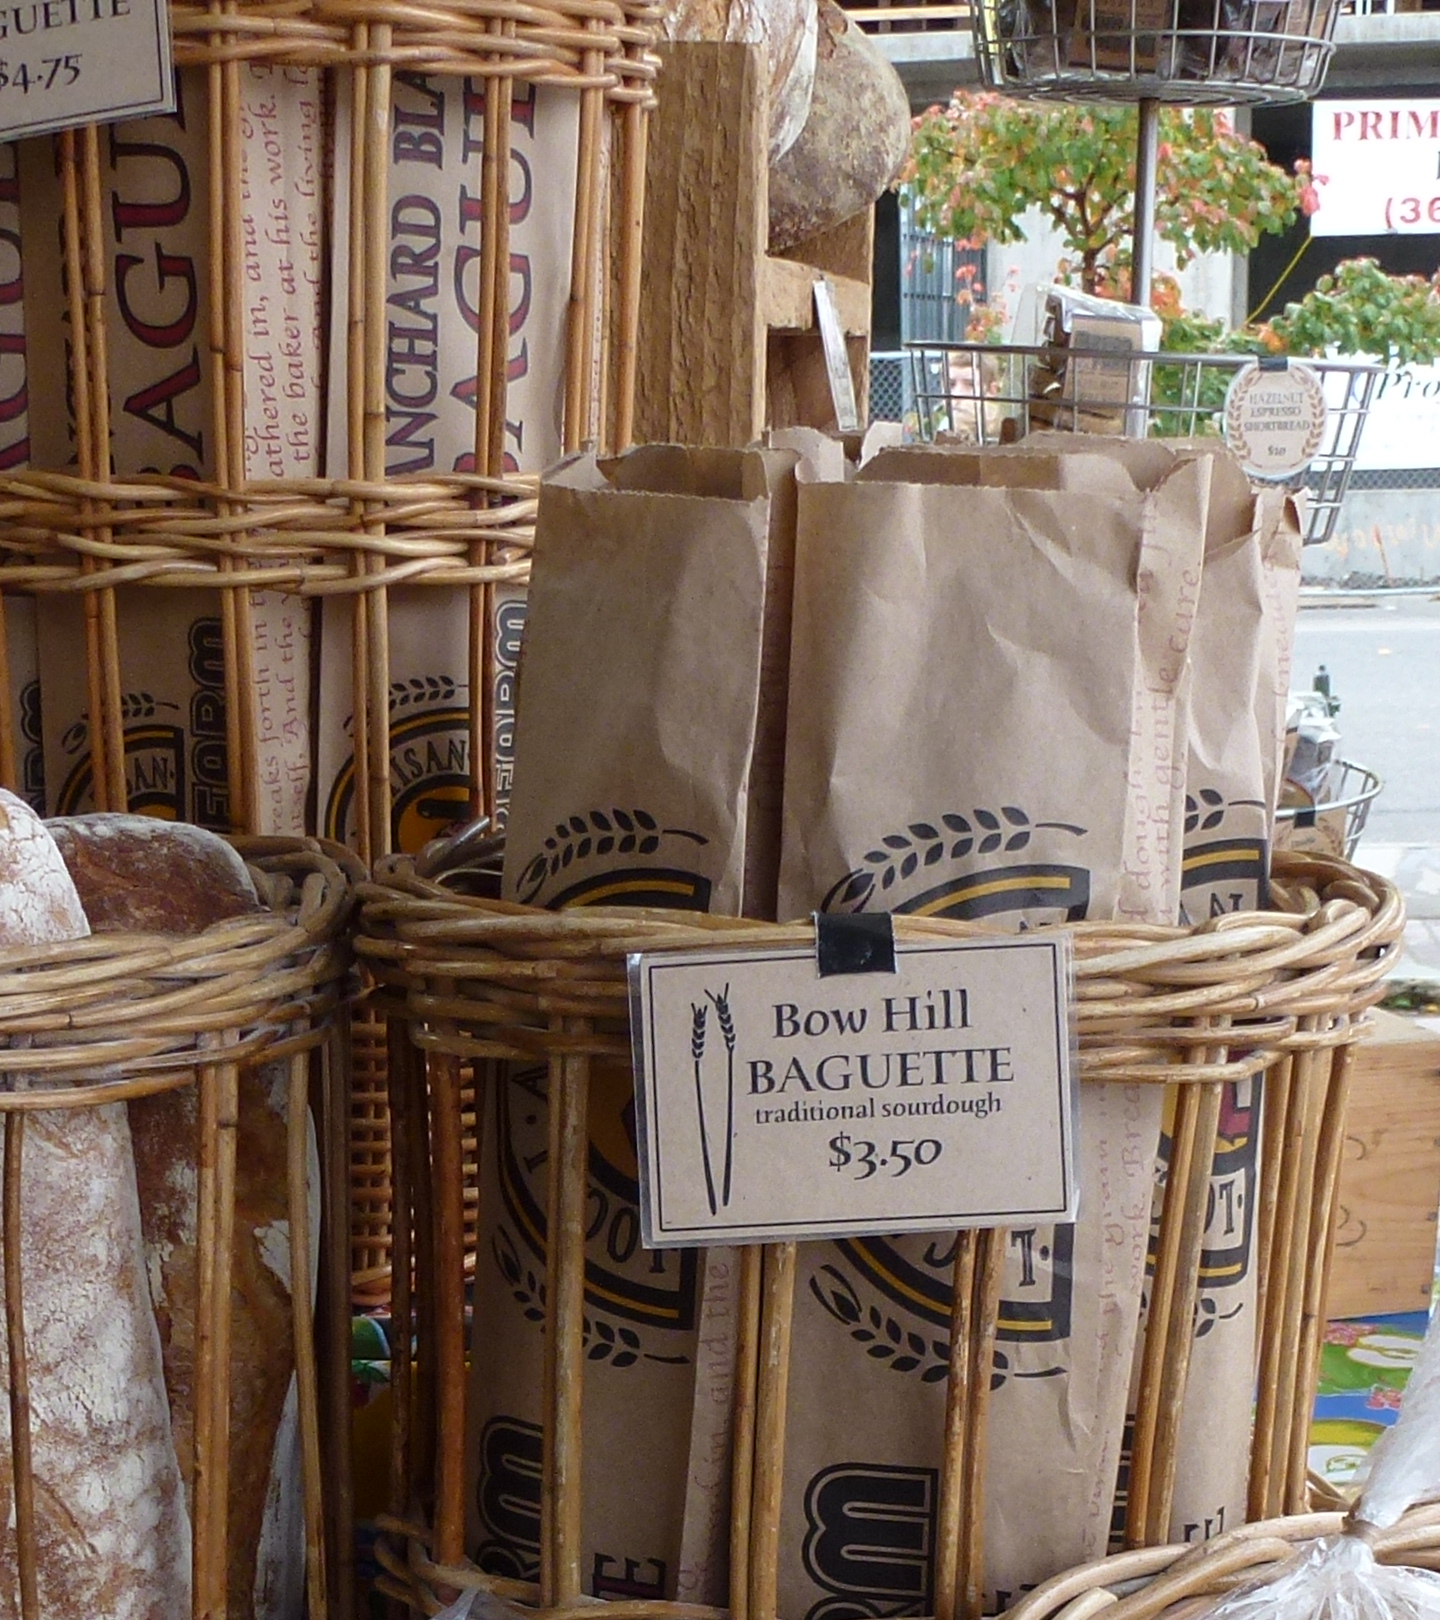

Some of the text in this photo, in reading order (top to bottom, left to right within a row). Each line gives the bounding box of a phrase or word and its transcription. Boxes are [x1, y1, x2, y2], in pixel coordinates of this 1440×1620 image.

[258, 93, 286, 181] work.
[293, 98, 320, 199] living
[269, 197, 289, 248] his
[278, 258, 296, 293] at
[276, 308, 307, 400] baker
[250, 353, 284, 478] athered
[1249, 391, 1305, 405] HAZELNUT
[1250, 406, 1302, 418] ESPRESSO
[291, 416, 311, 463] the
[1243, 419, 1311, 432] SHORTBREAD
[277, 667, 301, 743] And
[254, 627, 293, 836] reaks forth in
[773, 987, 974, 1039] Bow Hill
[746, 1046, 1016, 1096] BAGUETTE
[754, 1091, 1003, 1126] traditional sourdough
[828, 1131, 944, 1181] $3.50
